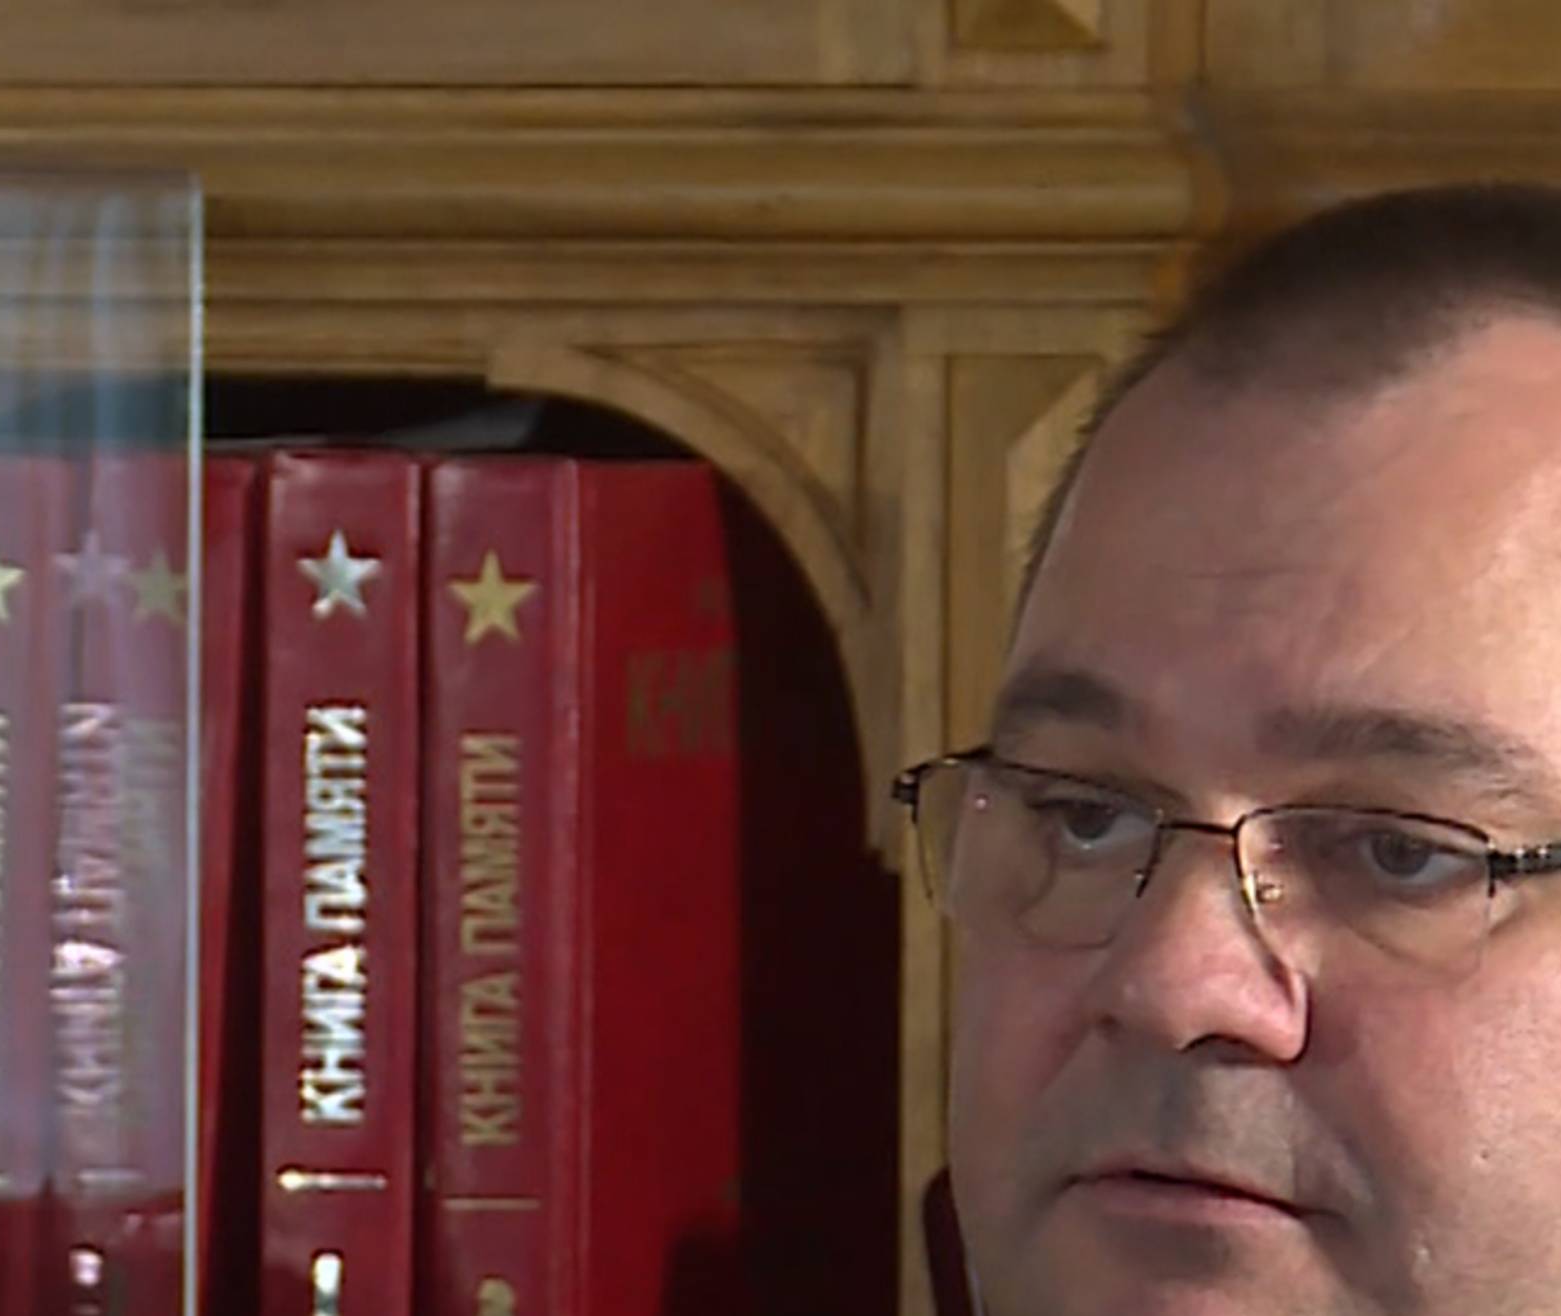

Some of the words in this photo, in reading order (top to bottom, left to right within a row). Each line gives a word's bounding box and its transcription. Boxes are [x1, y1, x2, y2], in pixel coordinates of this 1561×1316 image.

[304, 706, 366, 932] ПАМЯТИ
[460, 733, 521, 955] ПАМЯТИ
[302, 944, 366, 1124] КНИГА
[459, 974, 520, 1148] КНИГА
